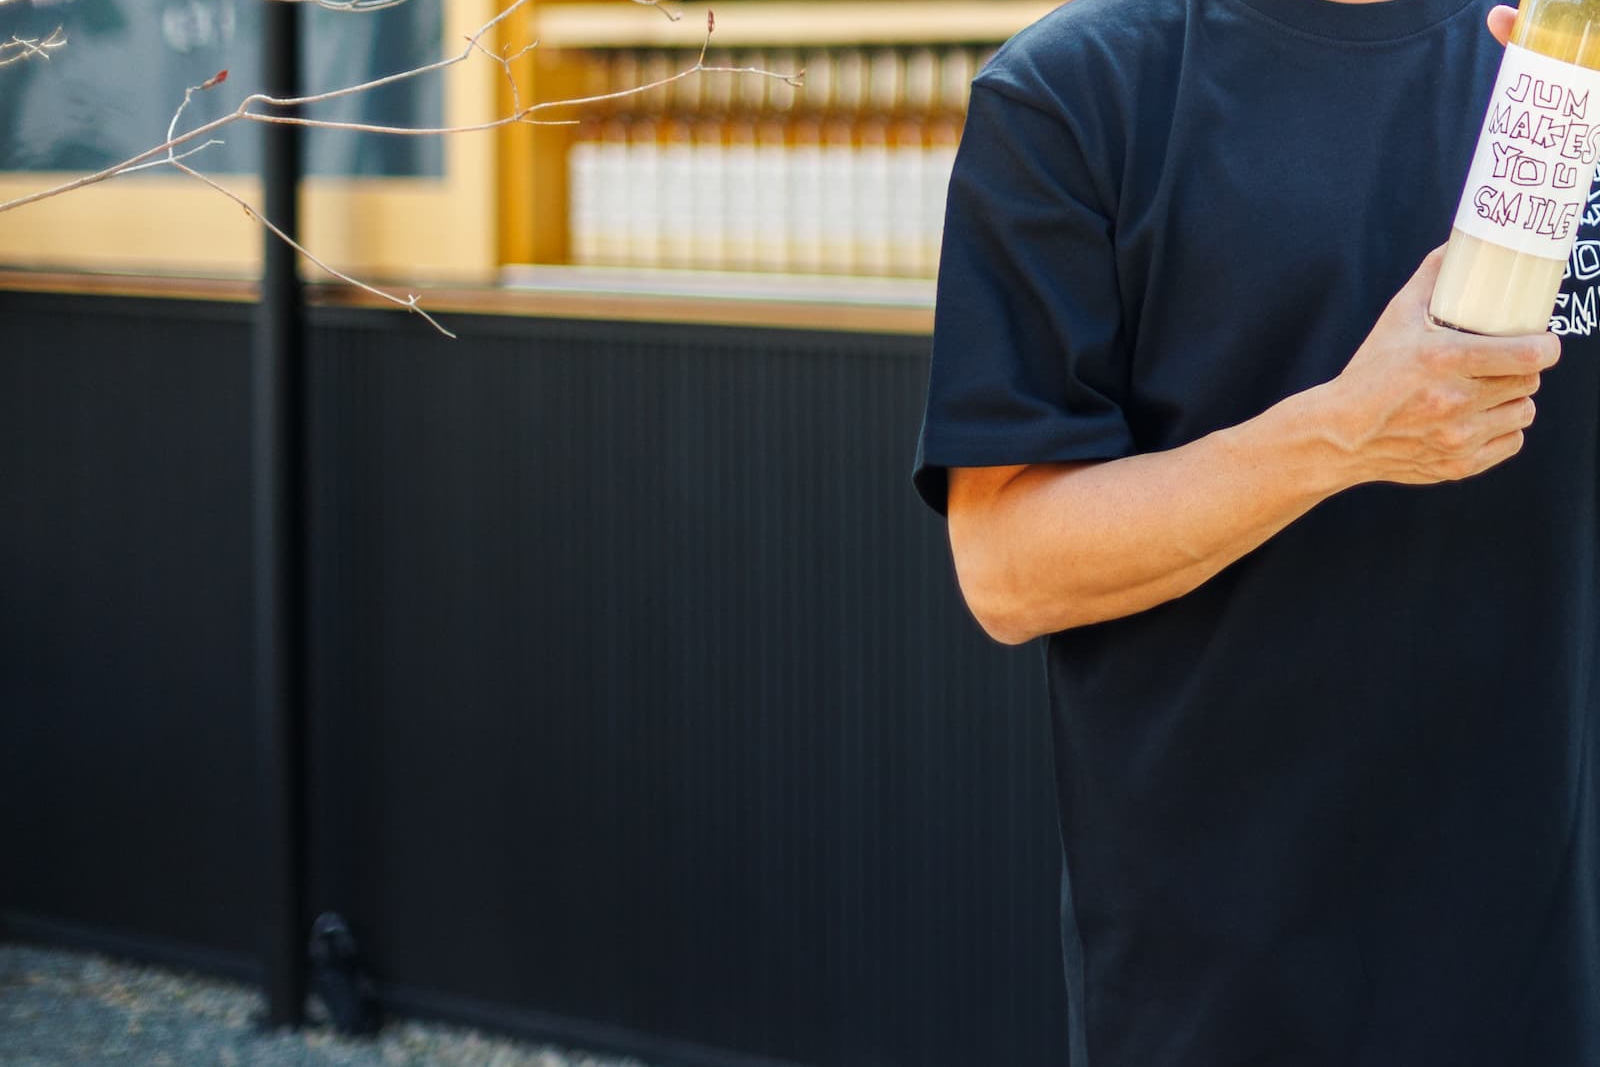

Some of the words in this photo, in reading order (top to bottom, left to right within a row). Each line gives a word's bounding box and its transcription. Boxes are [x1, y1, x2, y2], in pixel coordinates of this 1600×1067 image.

[1505, 73, 1590, 120] JUN
[1492, 141, 1578, 189] YOU
[1473, 185, 1580, 240] SMILE
